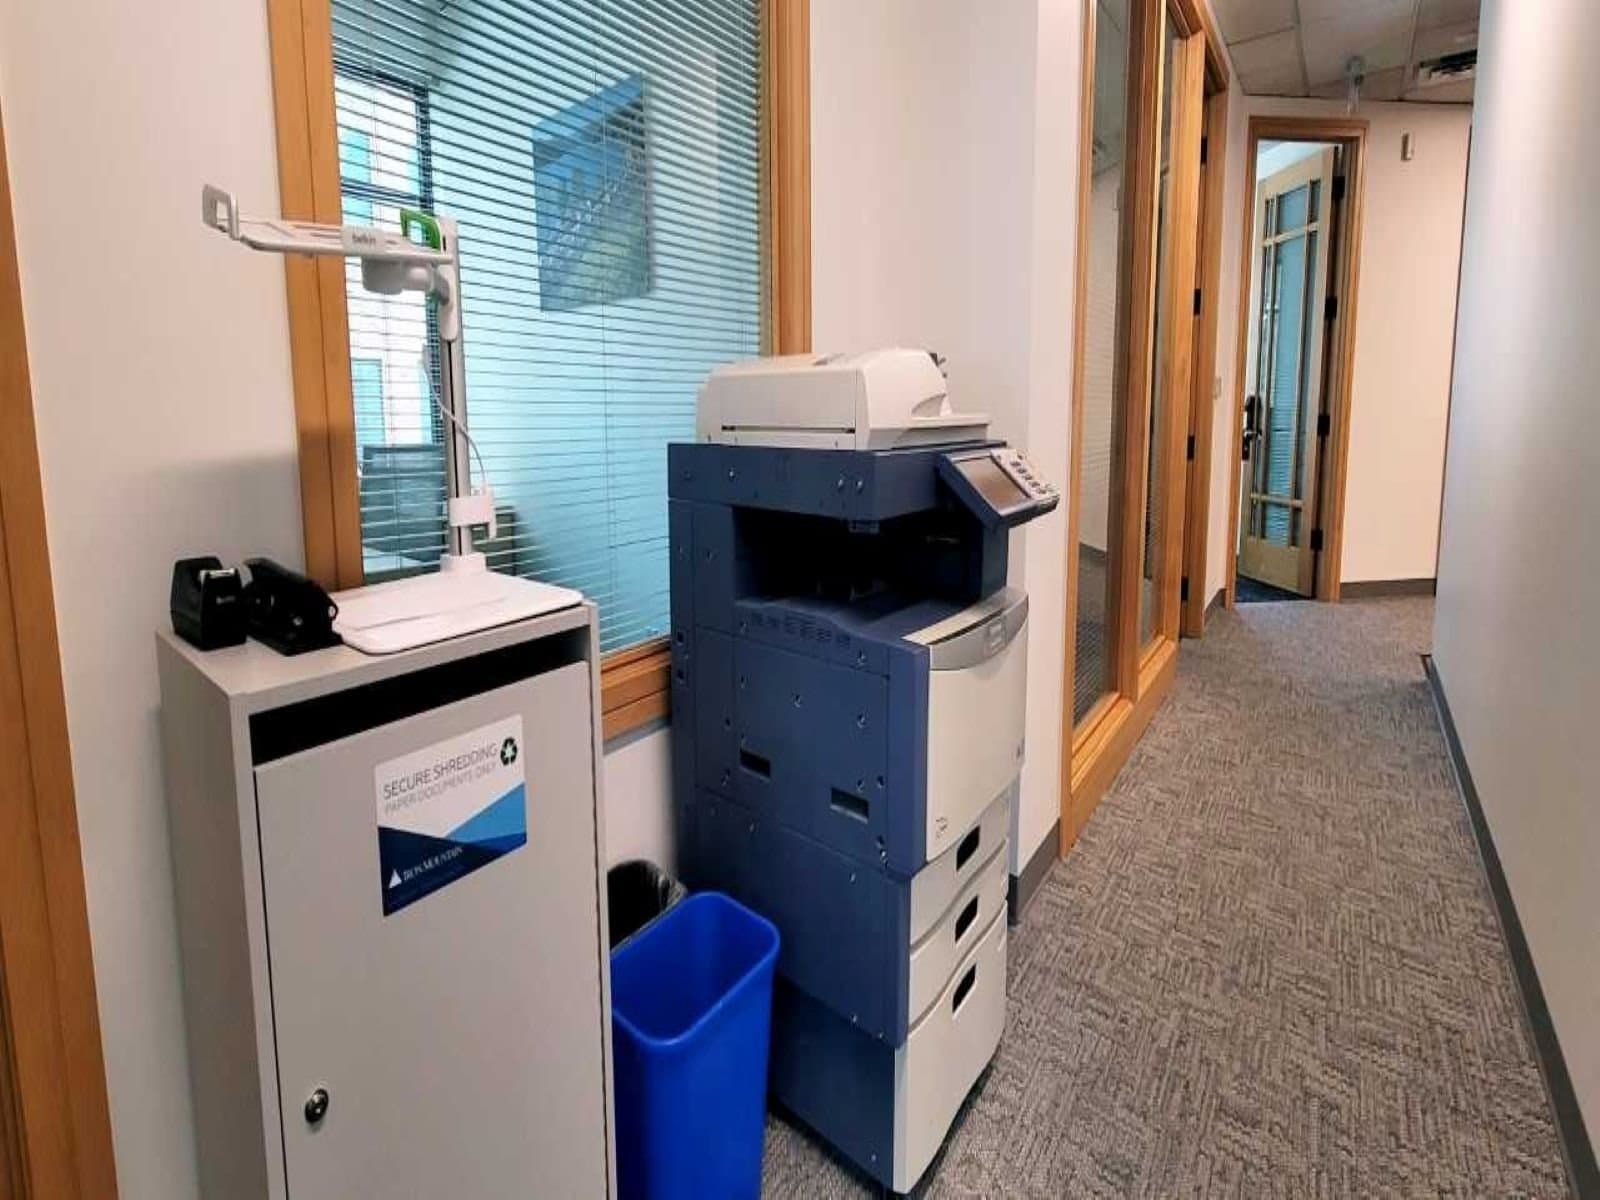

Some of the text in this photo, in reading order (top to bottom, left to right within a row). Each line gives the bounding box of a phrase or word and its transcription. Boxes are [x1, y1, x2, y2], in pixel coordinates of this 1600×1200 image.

[383, 743, 498, 800] SECURE SHREDDING
[475, 762, 498, 778] ONLY
